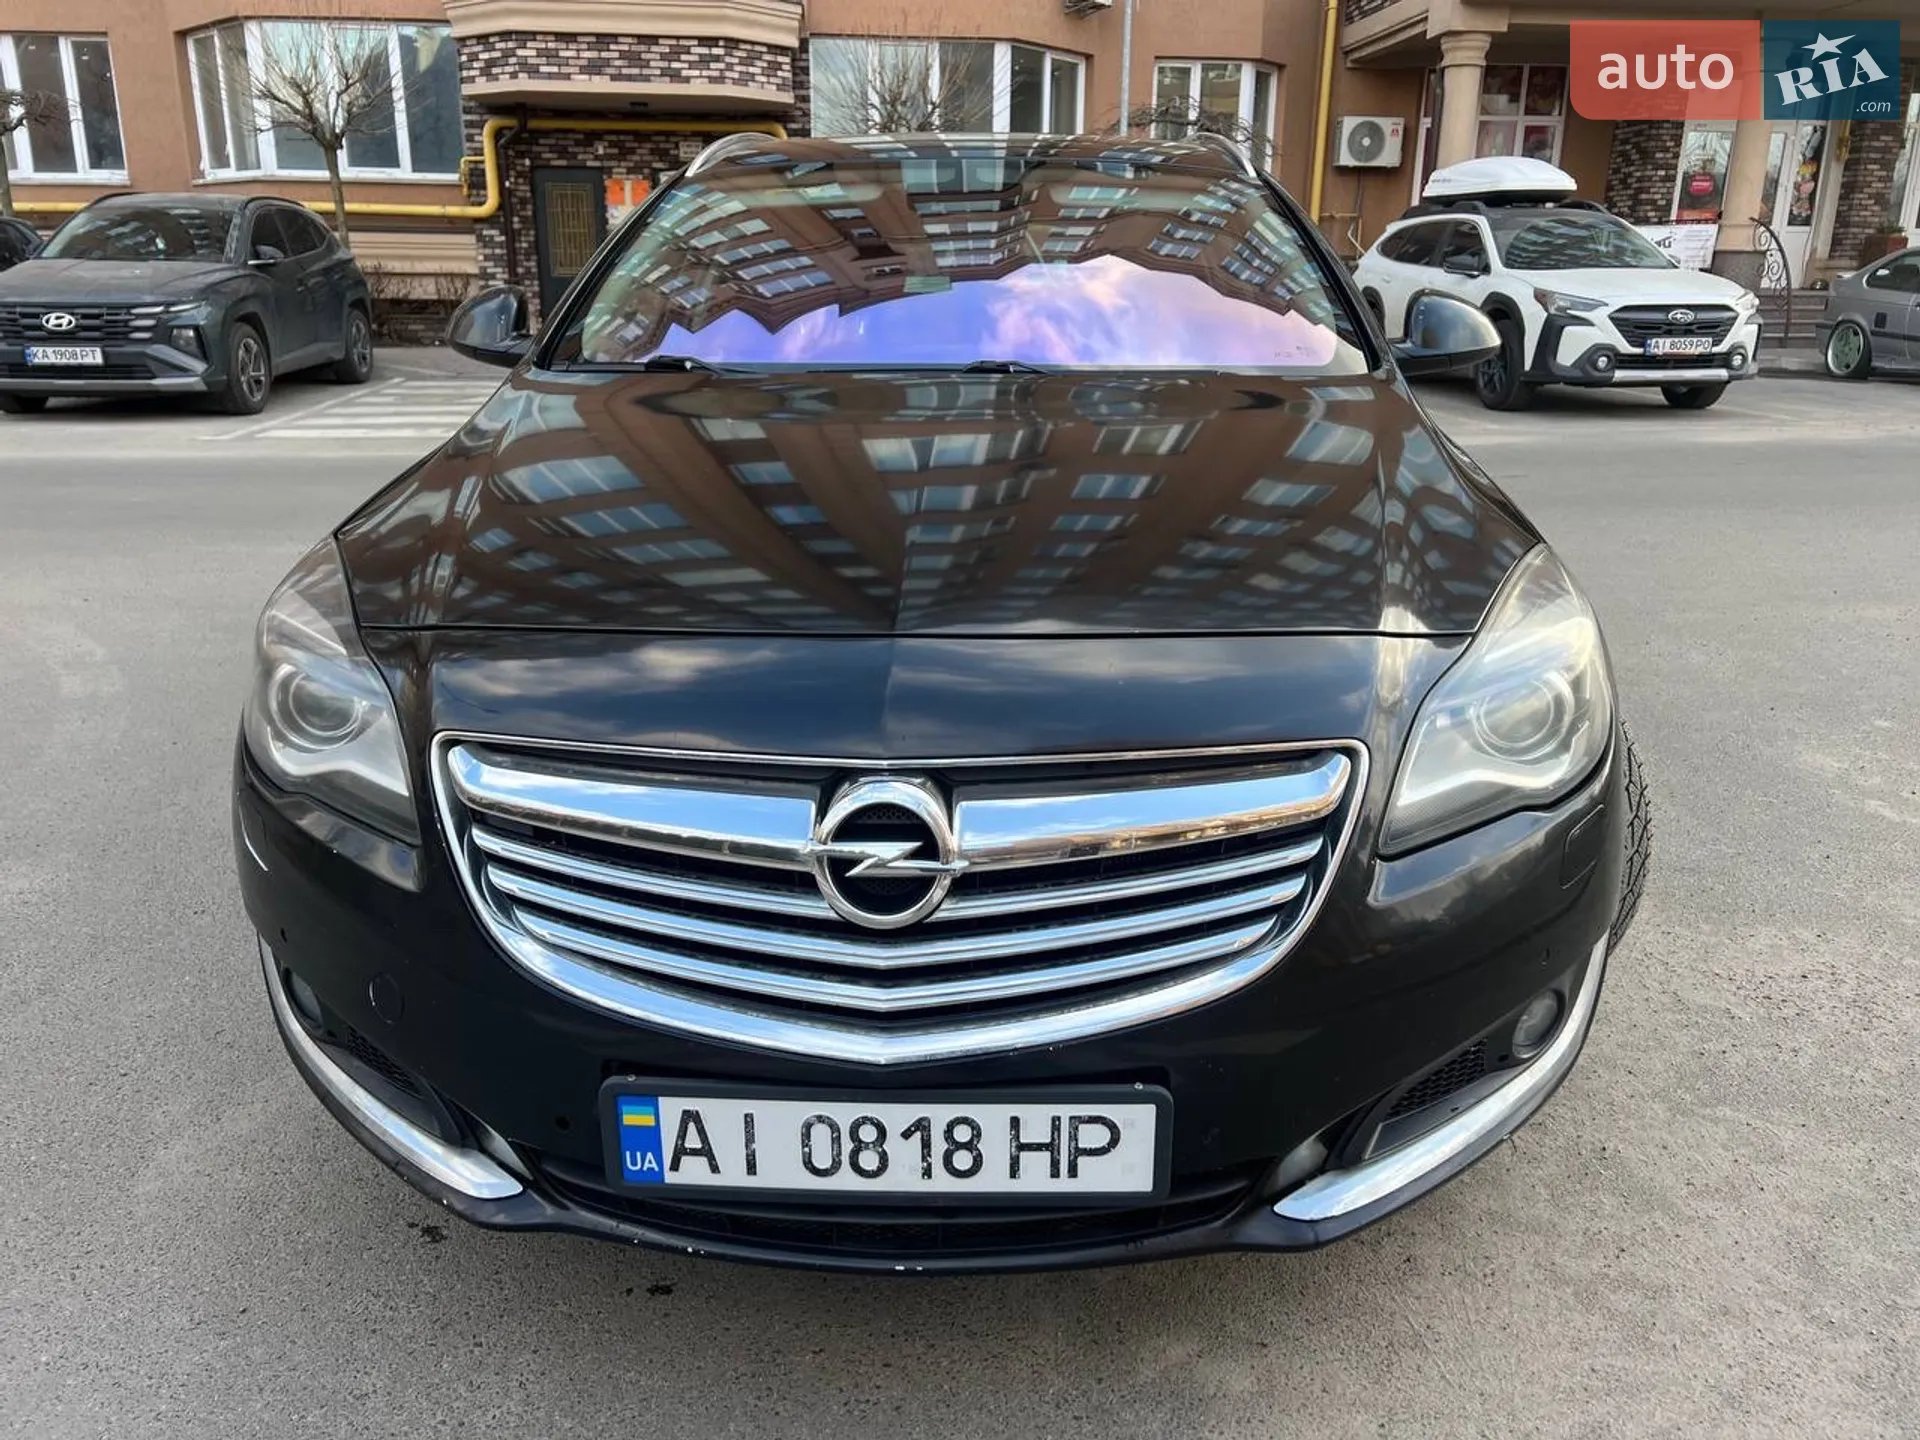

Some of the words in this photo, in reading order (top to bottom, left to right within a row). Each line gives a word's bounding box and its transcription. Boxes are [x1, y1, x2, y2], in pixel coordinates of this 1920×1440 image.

[1652, 339, 1666, 351] AI
[31, 348, 50, 361] KA
[52, 349, 79, 361] 1908
[80, 349, 97, 361] PT
[668, 1108, 758, 1176] AI
[800, 1113, 984, 1180] 0818
[1009, 1115, 1122, 1180] HP
[625, 1151, 660, 1172] UA
